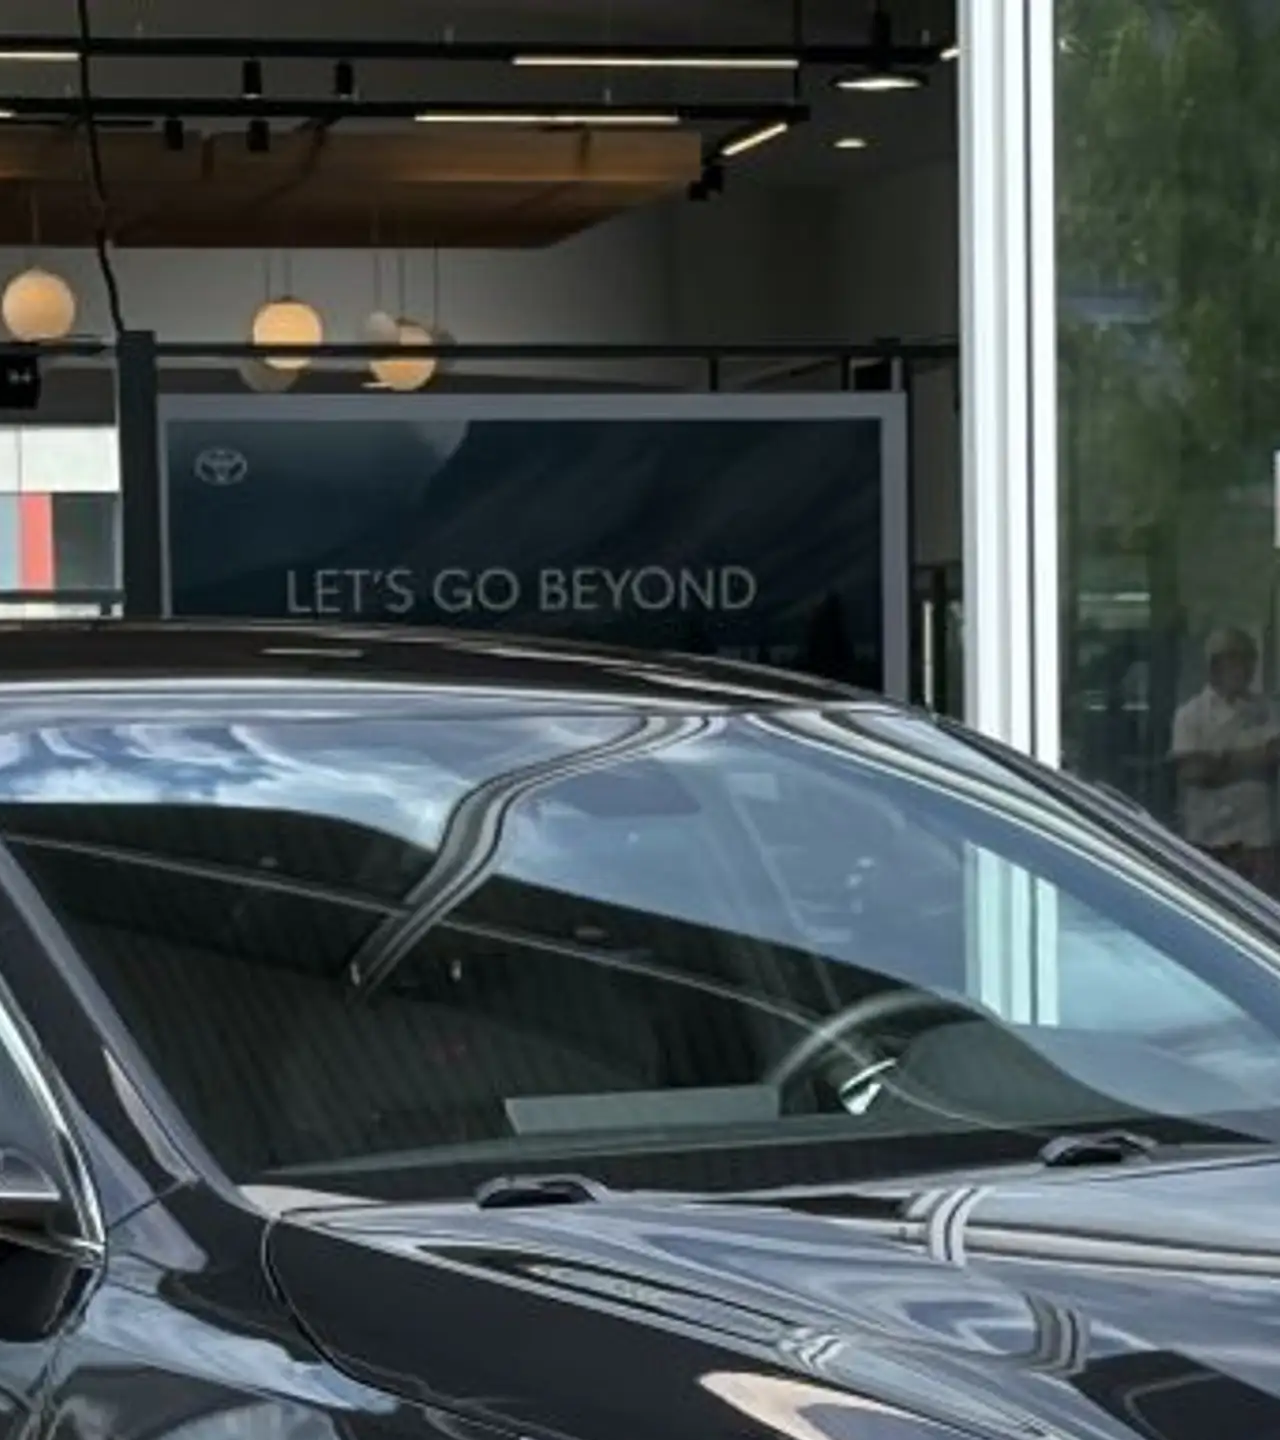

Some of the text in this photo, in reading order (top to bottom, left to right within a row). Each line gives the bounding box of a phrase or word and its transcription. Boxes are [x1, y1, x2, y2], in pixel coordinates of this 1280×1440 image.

[285, 564, 758, 615] LET'S GO BEYOND
